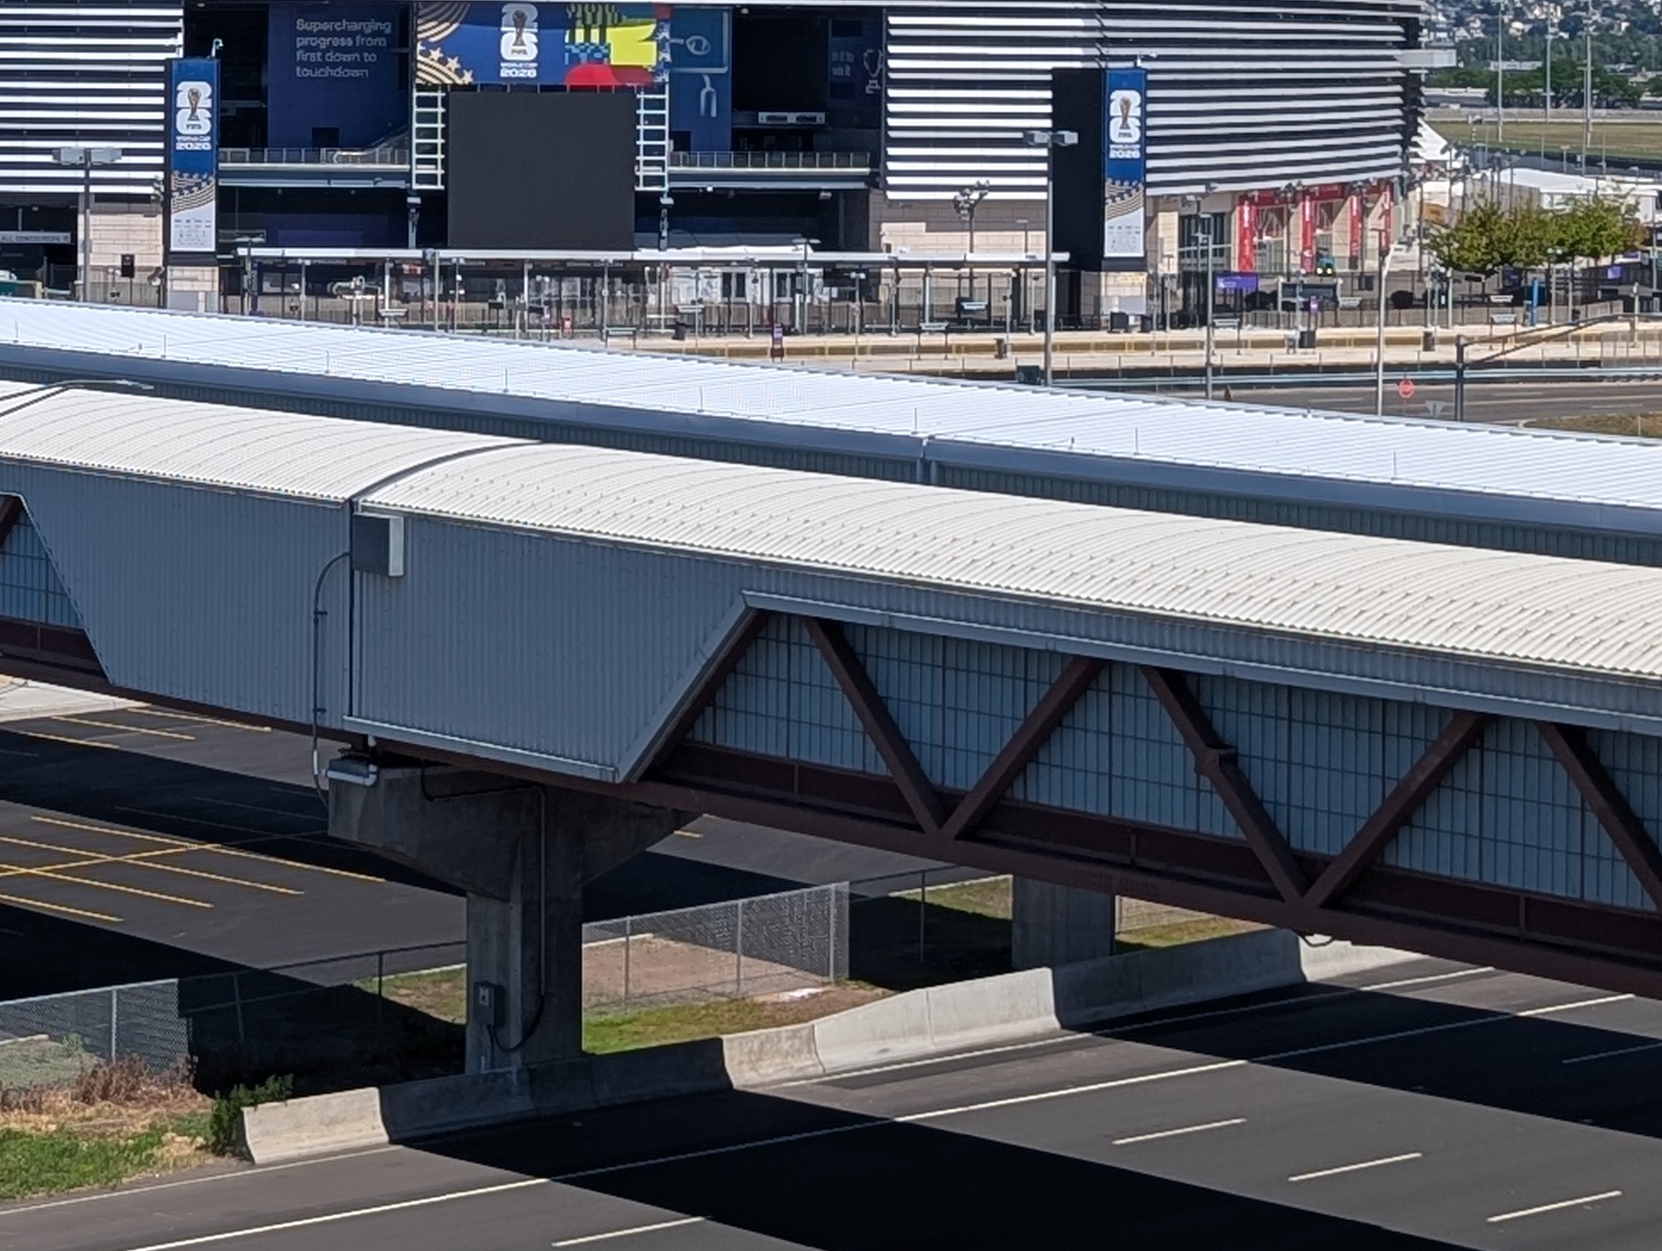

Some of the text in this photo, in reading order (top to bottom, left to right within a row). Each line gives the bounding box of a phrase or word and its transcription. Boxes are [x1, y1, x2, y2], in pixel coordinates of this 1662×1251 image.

[296, 18, 392, 34] Supercharging
[296, 34, 387, 49] progress from
[296, 49, 377, 62] first down to
[296, 65, 369, 78] touchdown
[500, 69, 537, 78] 2026
[176, 142, 211, 150] 2026
